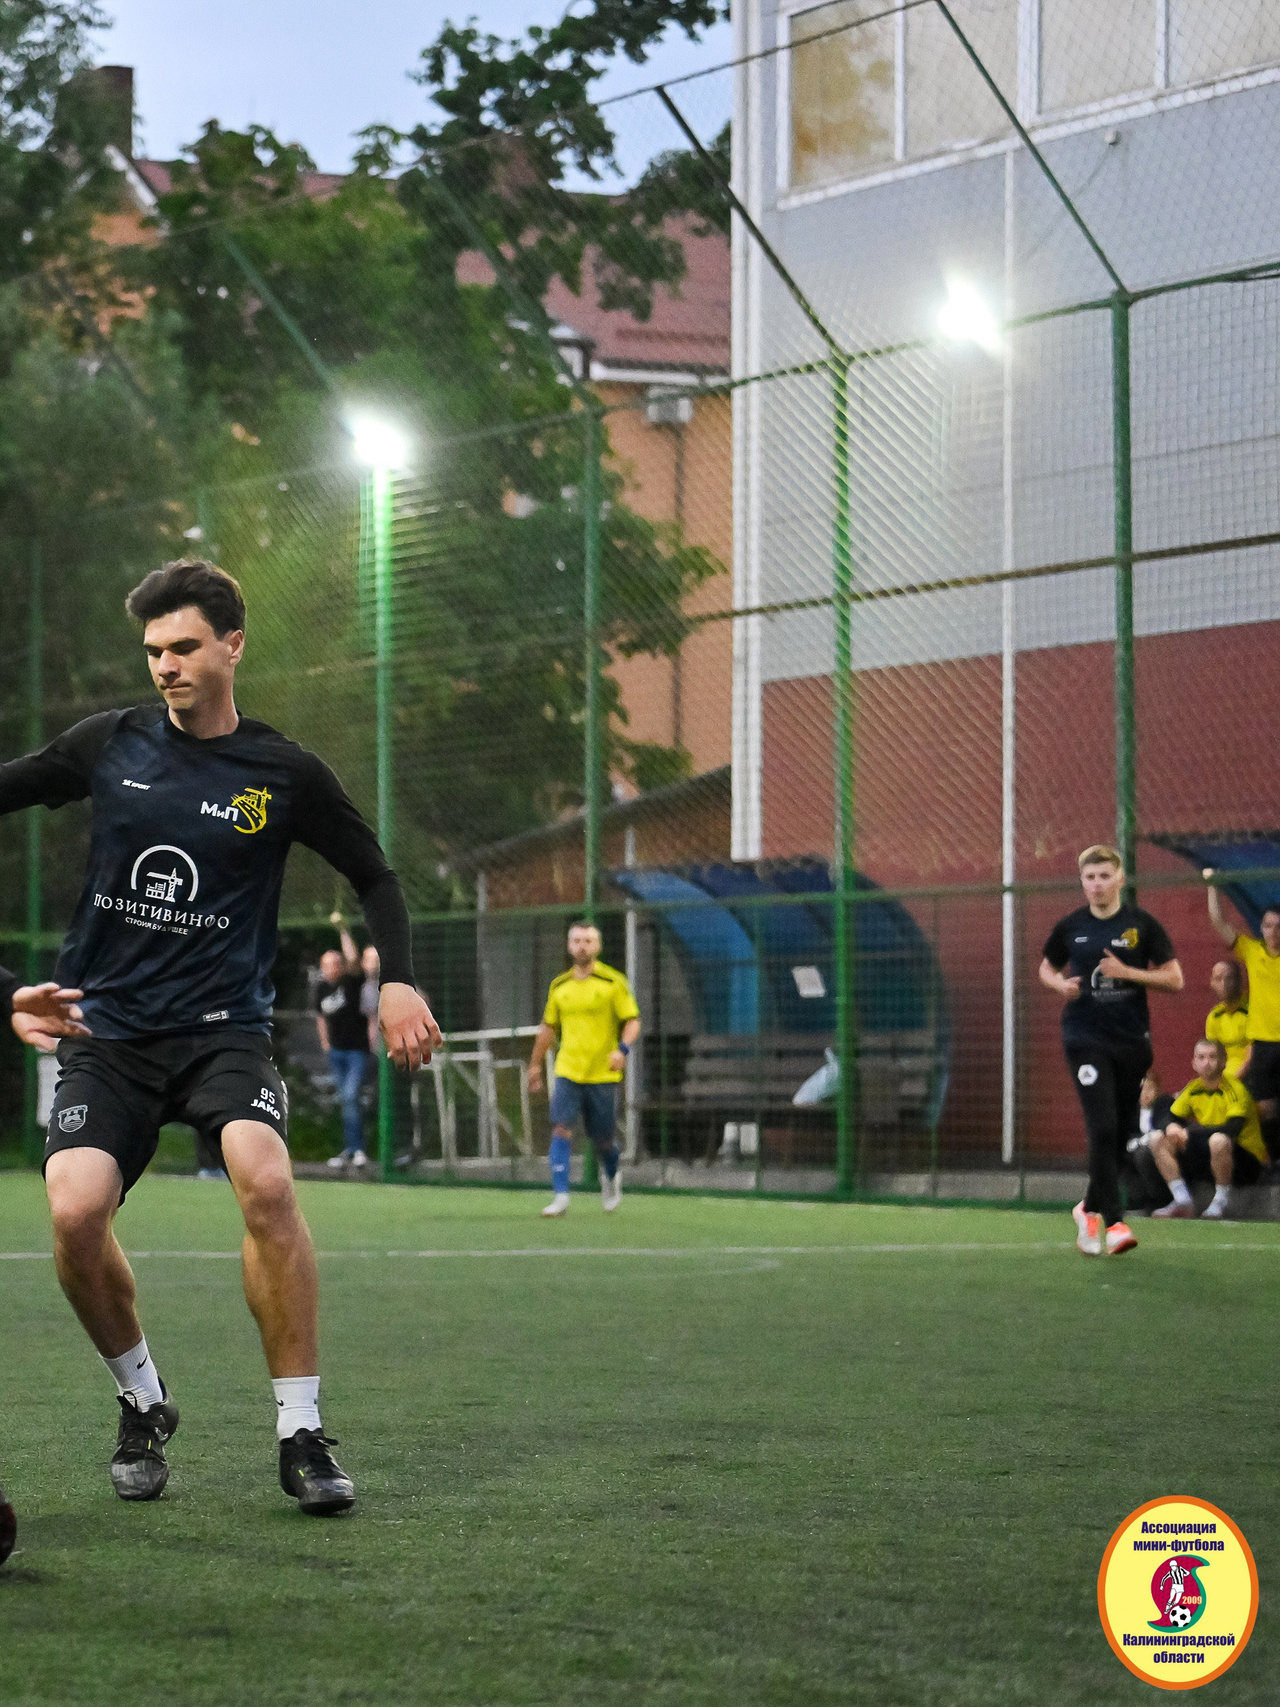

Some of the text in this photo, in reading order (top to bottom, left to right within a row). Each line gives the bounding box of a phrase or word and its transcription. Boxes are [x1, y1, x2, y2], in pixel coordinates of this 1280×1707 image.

[200, 801, 239, 822] МиП
[93, 893, 230, 929] ПОЗИТИВИНФО
[124, 916, 152, 929] СТРОИМ
[260, 1087, 276, 1105] 95
[250, 1098, 281, 1121] JAKO
